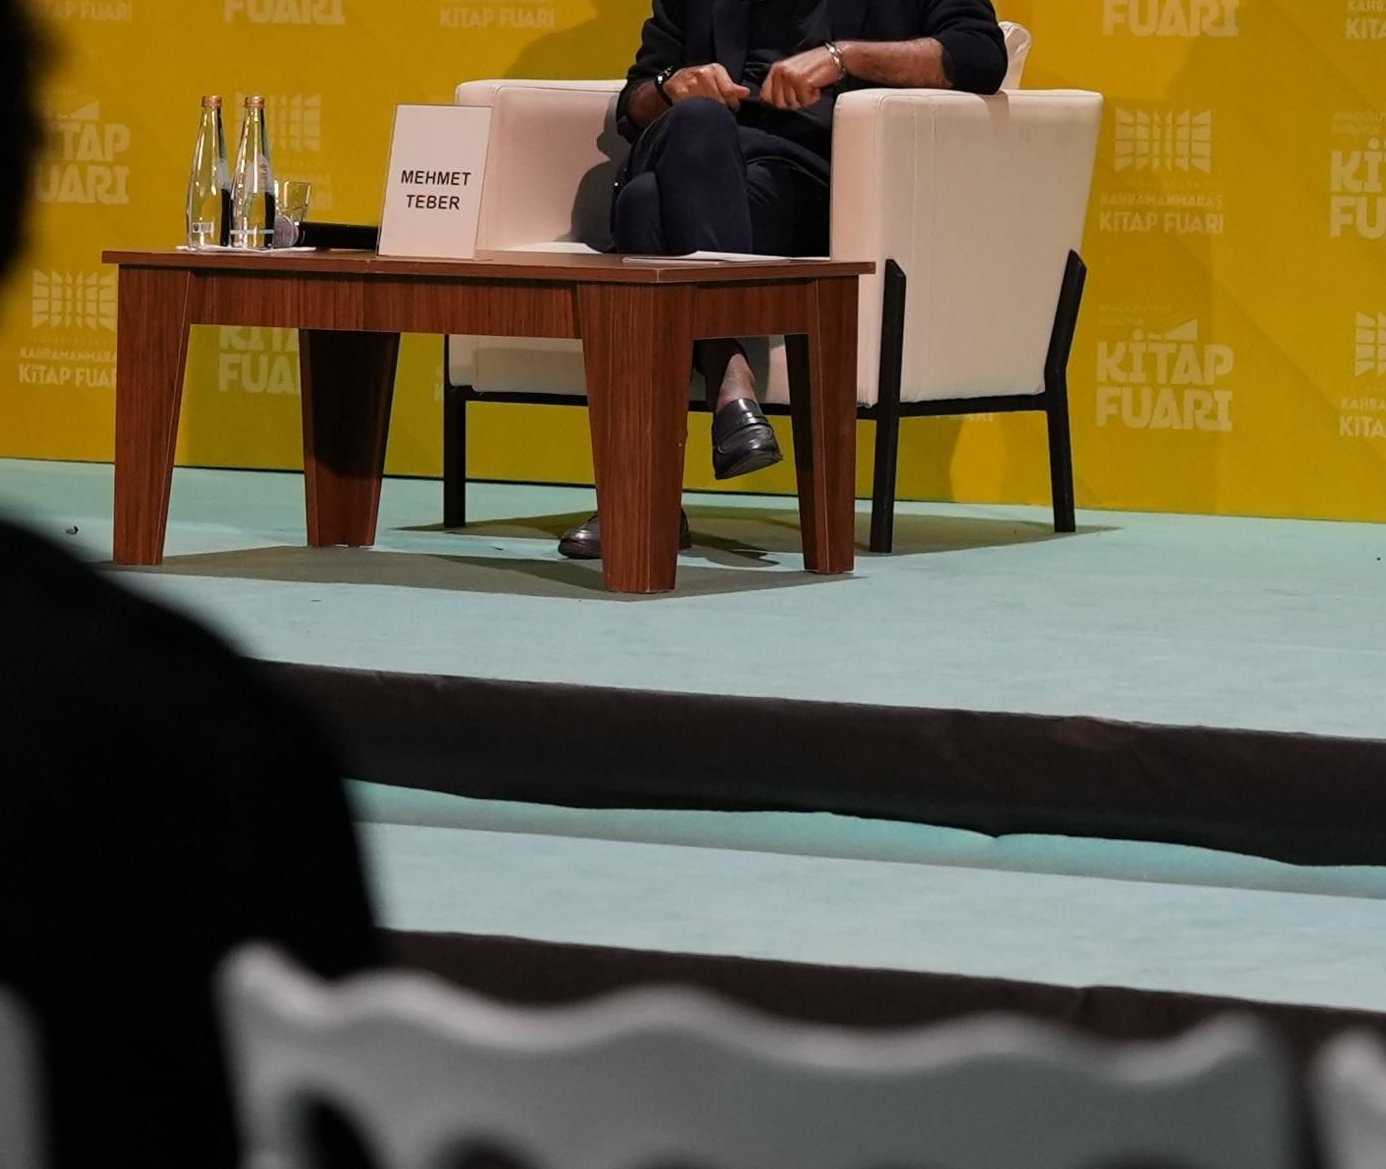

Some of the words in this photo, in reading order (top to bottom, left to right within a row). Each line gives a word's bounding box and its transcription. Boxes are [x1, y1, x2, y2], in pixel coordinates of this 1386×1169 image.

[400, 170, 472, 186] MEHMET
[406, 194, 461, 210] TEBER
[1095, 387, 1234, 432] FUARI
